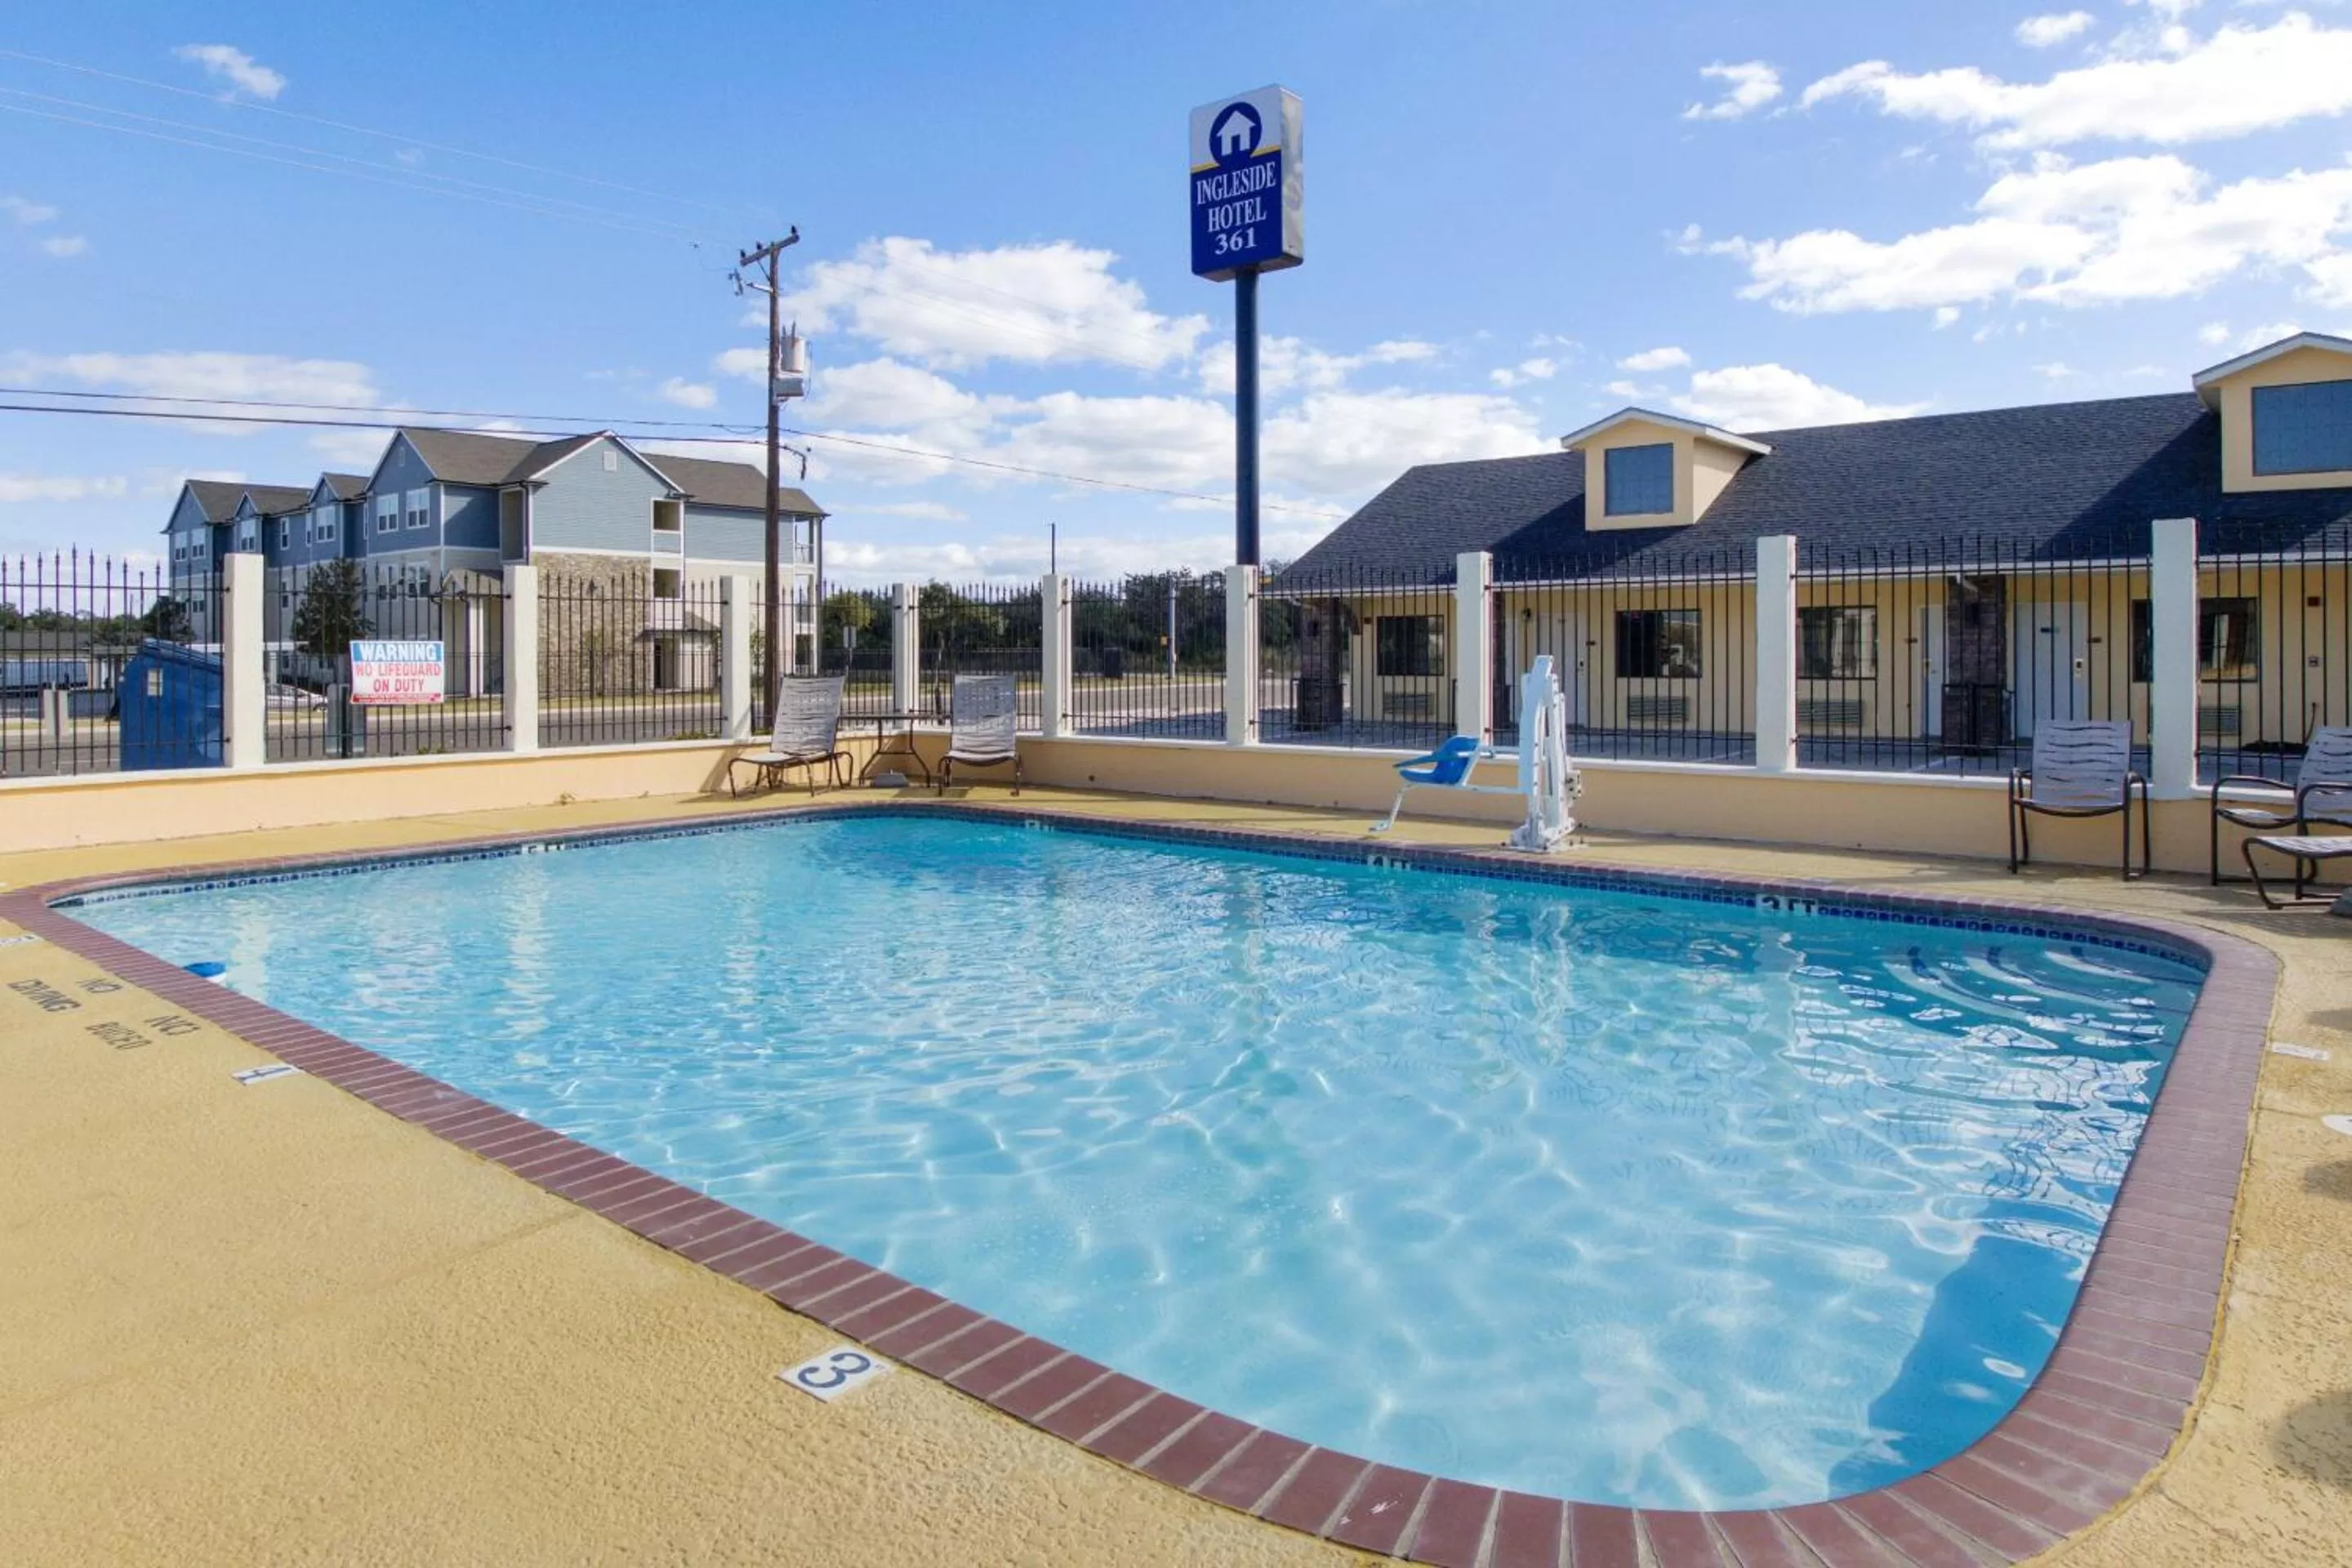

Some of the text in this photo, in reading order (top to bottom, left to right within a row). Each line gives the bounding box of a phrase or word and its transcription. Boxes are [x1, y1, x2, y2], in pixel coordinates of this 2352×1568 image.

[1196, 162, 1276, 205] INGLESIDE
[1208, 197, 1267, 233] HOTEL
[1215, 227, 1258, 255] 361
[359, 643, 437, 662] WARNING
[355, 663, 441, 676] NO LIFEGUARD
[373, 679, 425, 693] ON DUTY
[144, 1015, 202, 1036] NO
[798, 1352, 871, 1388] 3
